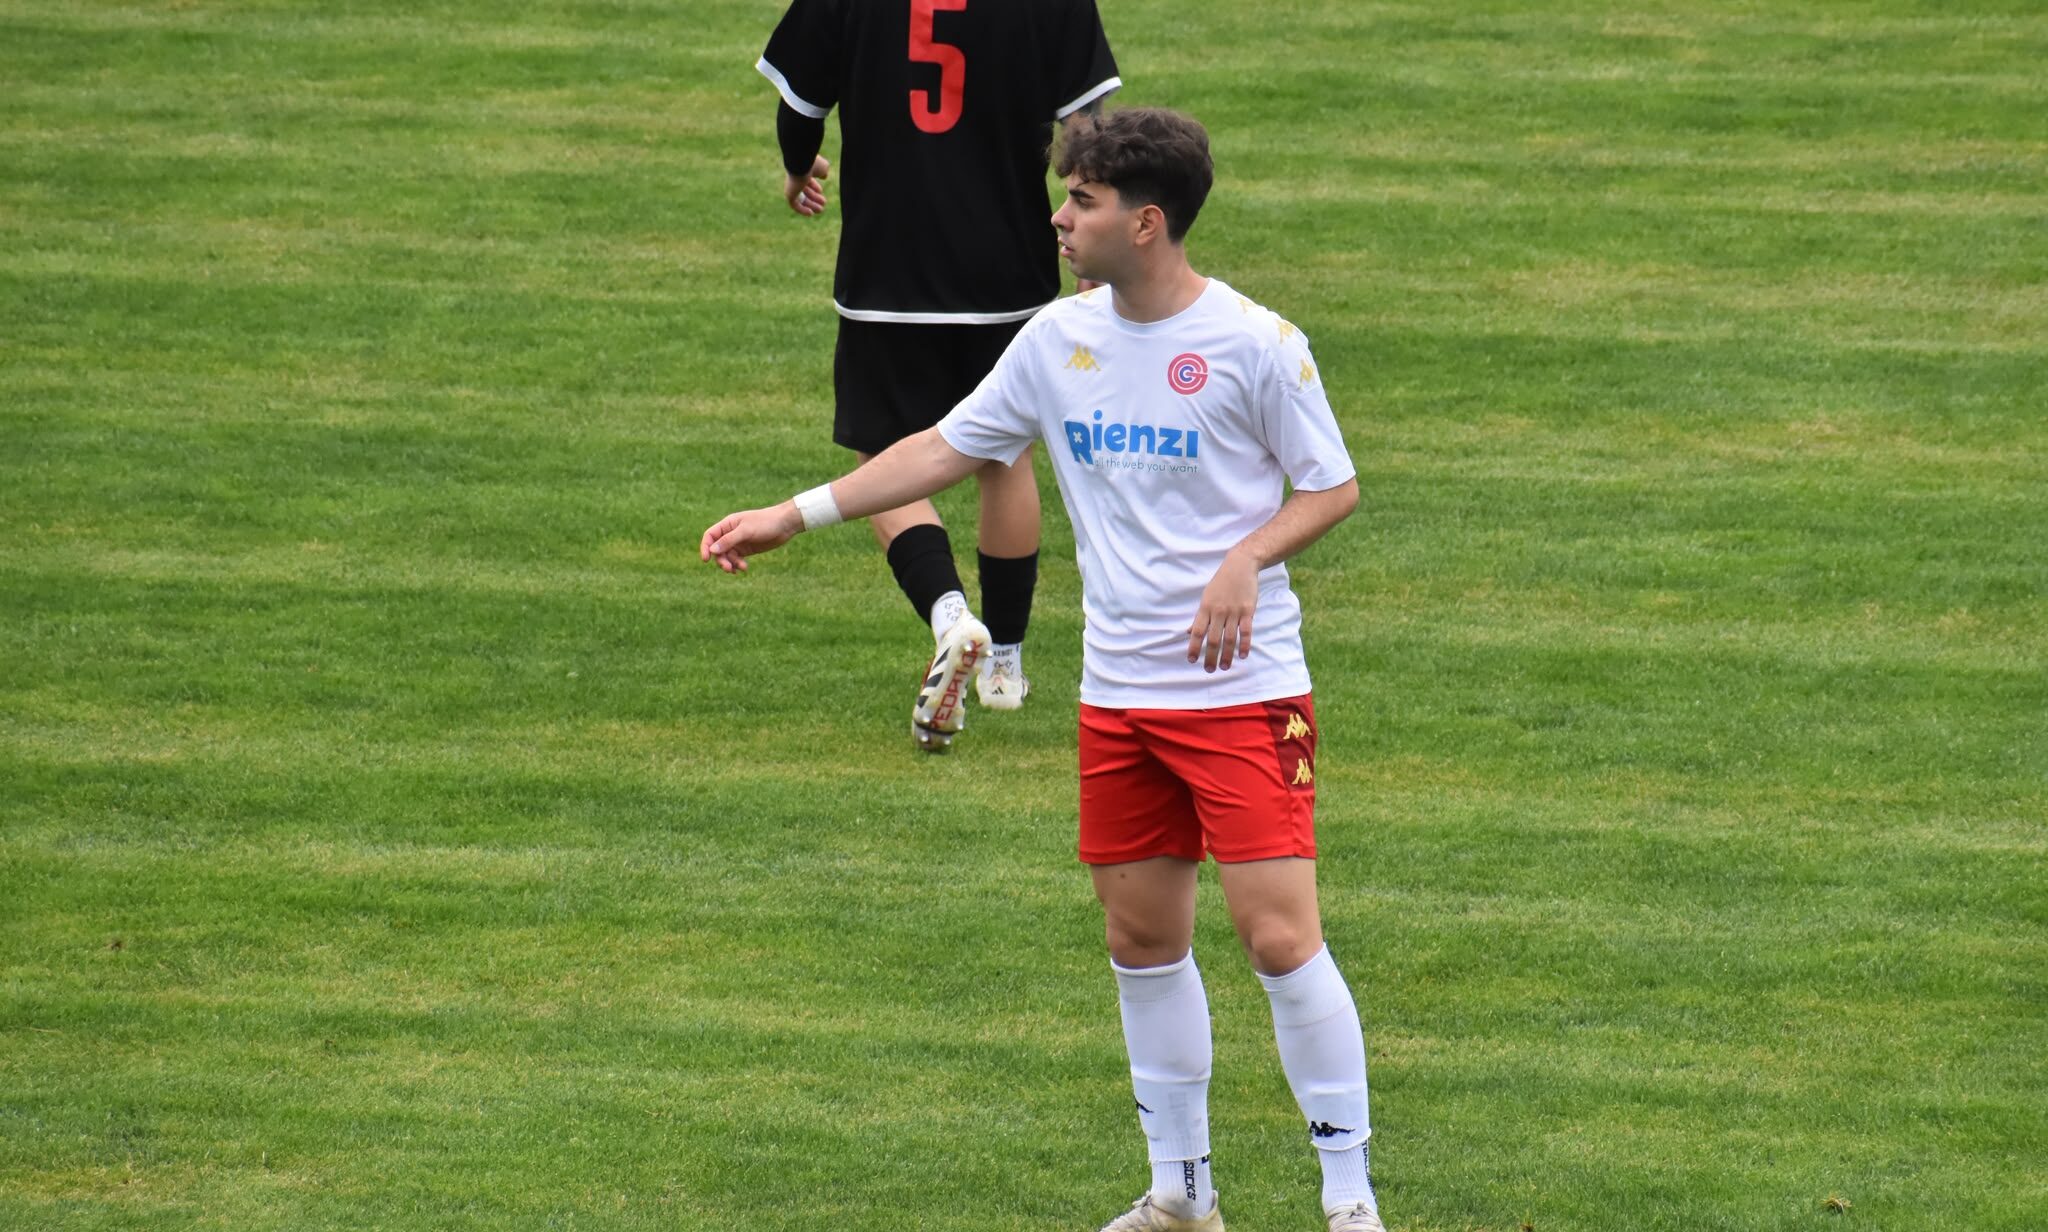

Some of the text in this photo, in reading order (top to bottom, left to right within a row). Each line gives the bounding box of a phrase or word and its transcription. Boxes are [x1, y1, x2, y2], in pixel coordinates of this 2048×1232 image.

[908, 0, 967, 133] 5
[1106, 457, 1120, 469] the
[1121, 459, 1145, 470] web
[1147, 463, 1166, 472] you
[1169, 464, 1198, 473] want
[1183, 1160, 1197, 1201] SOCKS
